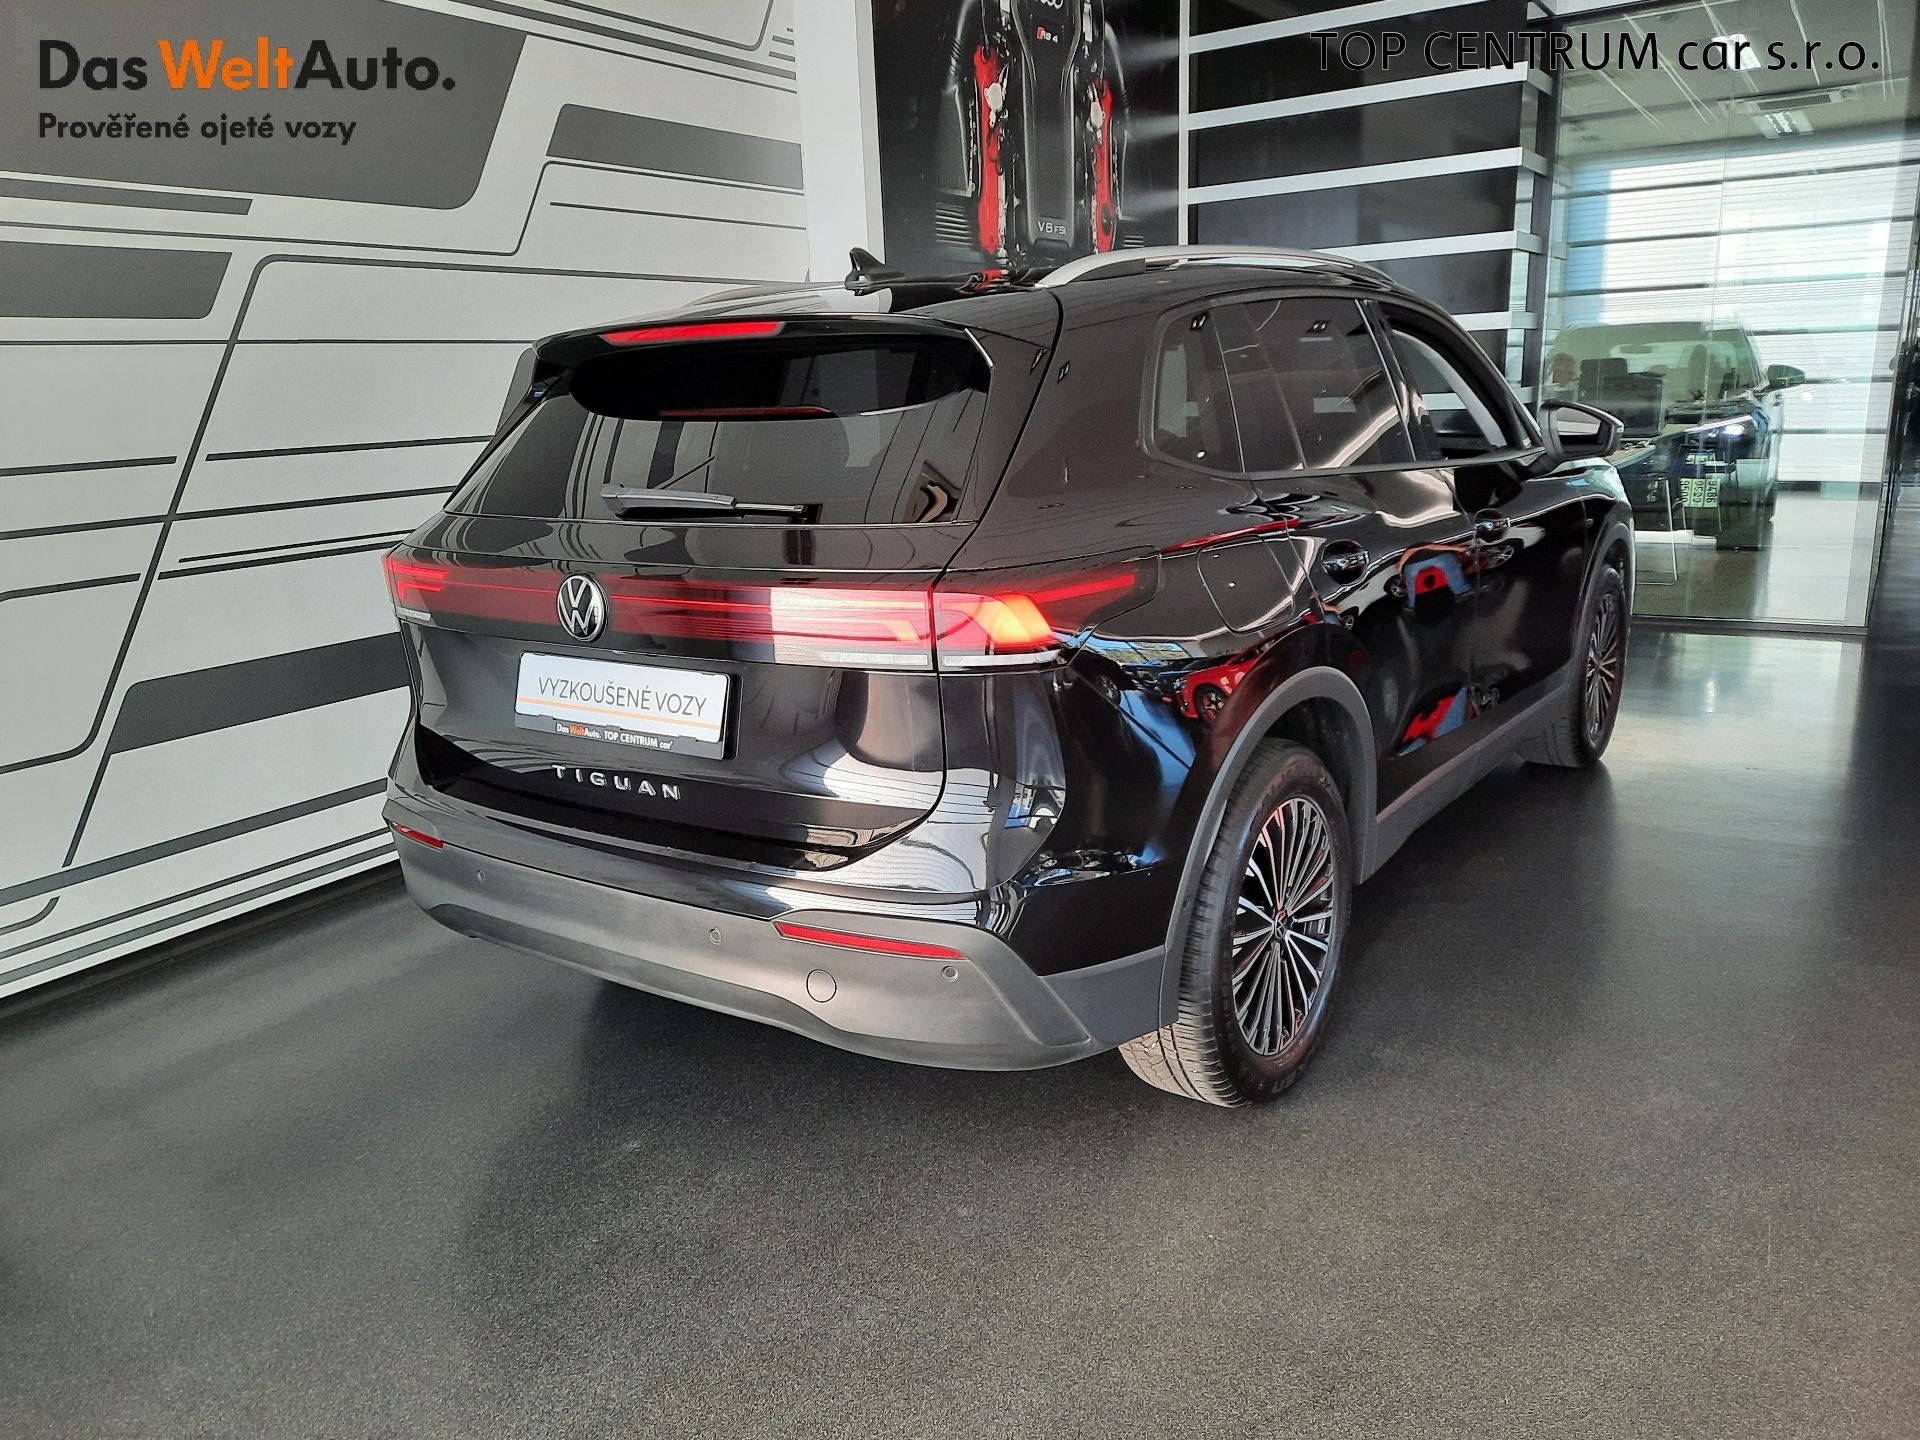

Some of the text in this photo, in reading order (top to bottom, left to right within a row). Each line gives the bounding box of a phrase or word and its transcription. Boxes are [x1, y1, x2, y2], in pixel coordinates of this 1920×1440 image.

[538, 676, 708, 718] VYZKOUŠENÉ VOZY
[556, 723, 569, 734] Das
[603, 730, 619, 741] TOP
[620, 733, 658, 748] CENTRUM
[551, 764, 681, 800] TIGUAN
